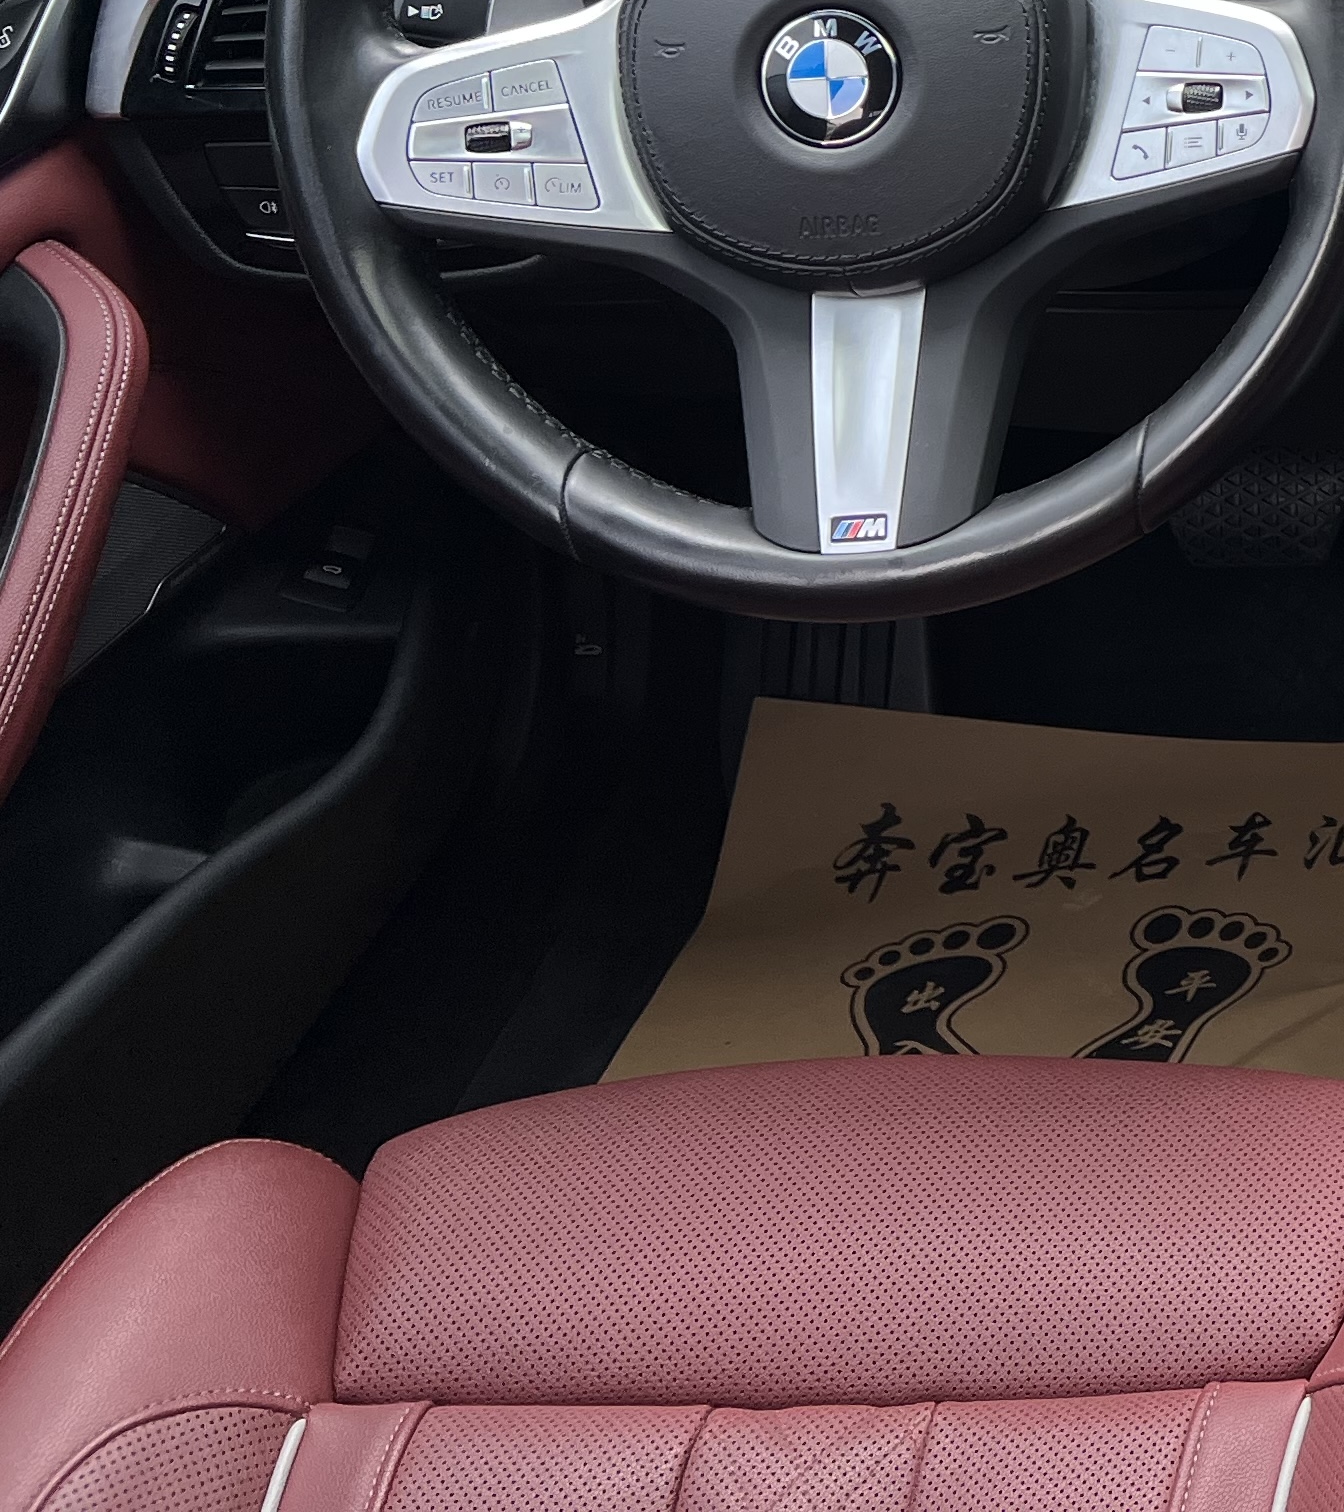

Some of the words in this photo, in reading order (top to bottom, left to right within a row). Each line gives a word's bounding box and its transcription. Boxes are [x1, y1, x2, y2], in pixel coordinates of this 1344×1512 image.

[775, 18, 883, 60] BMW
[501, 80, 553, 97] CANCEL
[427, 90, 483, 110] RESUME
[429, 171, 455, 184] SET
[558, 182, 582, 194] LIM
